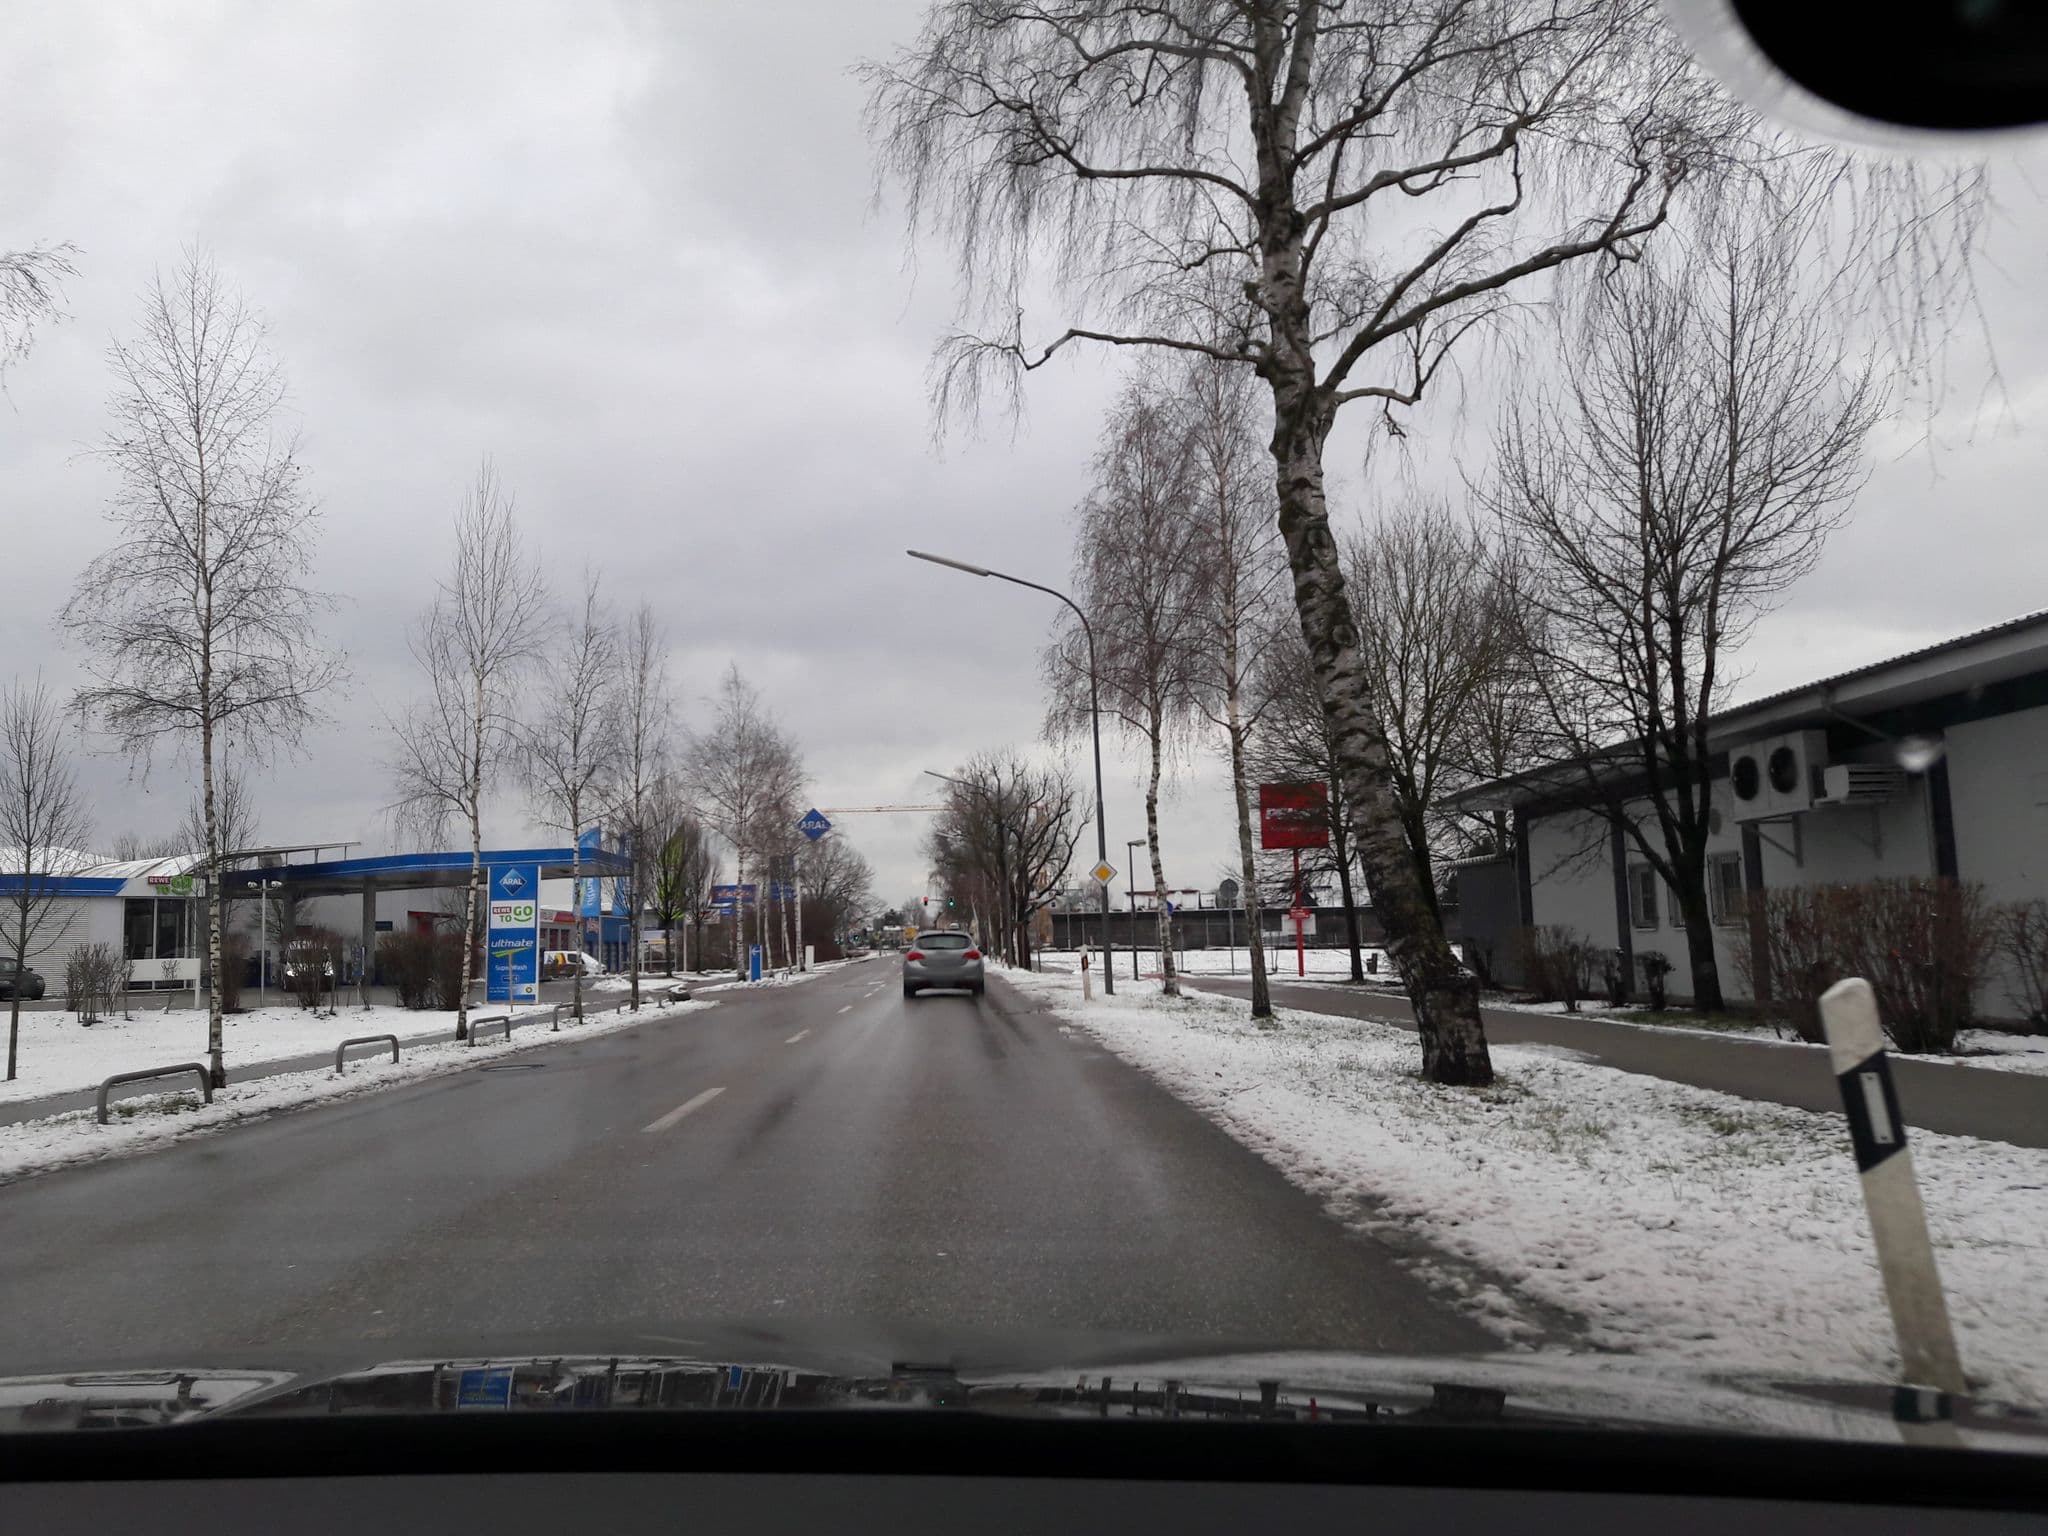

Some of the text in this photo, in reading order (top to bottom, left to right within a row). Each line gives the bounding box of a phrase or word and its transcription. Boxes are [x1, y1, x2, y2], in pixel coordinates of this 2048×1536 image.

[801, 821, 828, 829] ARAL
[500, 914, 511, 922] TO
[513, 905, 533, 916] GO
[491, 939, 534, 947] ultimate
